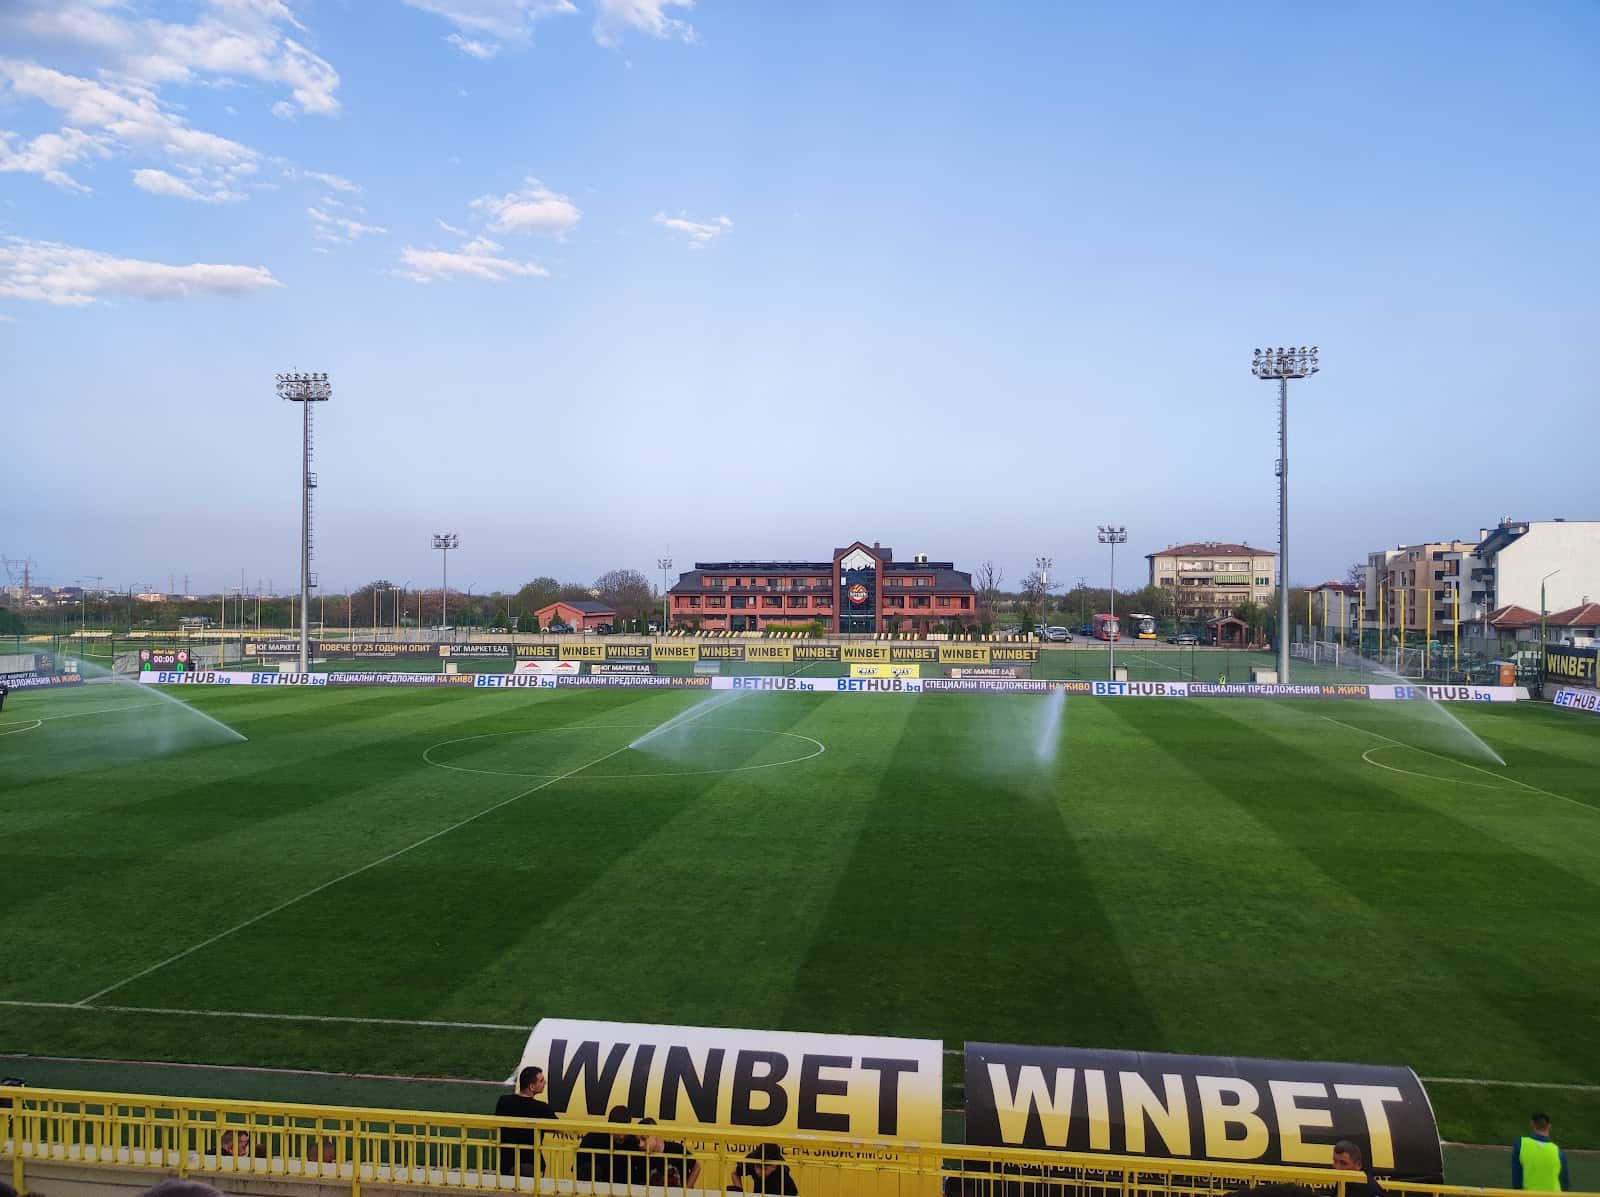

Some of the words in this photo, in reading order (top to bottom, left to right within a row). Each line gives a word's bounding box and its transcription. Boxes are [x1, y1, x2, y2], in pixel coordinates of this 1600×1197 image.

[320, 644, 351, 652] ПОВЕЧЕ
[352, 644, 362, 652] ОТ
[364, 644, 373, 652] 25
[374, 644, 408, 653] ГОДИНИ
[409, 644, 431, 652] ОПИТ
[516, 646, 557, 656] WINBET
[562, 646, 602, 656] WINBET
[608, 646, 649, 657] WINBET
[654, 647, 696, 657] WINBET
[702, 647, 743, 658] WINBET
[748, 648, 790, 657] WINBET
[796, 648, 838, 658] WINBET
[844, 648, 886, 658] WINBET
[892, 648, 936, 659] WINBET
[942, 649, 986, 659] WINBET
[992, 650, 1038, 660] WINBET
[1547, 653, 1595, 678] WINBET
[328, 674, 376, 683] СПЕЦИАЛНИ
[376, 674, 435, 684] ПРЕДЛОЖЕНИЯ
[477, 676, 554, 688] BETHUB.bg
[558, 676, 608, 685] СПЕЦИАЛНИ
[609, 676, 670, 686] ПРЕДЛОЖЕНИЯ
[672, 677, 684, 685] НА
[685, 678, 710, 686] ЖИВО
[732, 678, 814, 690] BETHUB.bg
[837, 679, 921, 692] BETHUB.bg
[924, 681, 978, 690] СПЕЦИАЛНИ
[980, 681, 1046, 691] ПРЕДЛОЖЕНИЯ
[1064, 682, 1090, 692] ЖИВО
[1095, 683, 1185, 697] BETHUB.bg
[1190, 684, 1246, 694] СПЕЦИАЛНИ
[1248, 685, 1320, 696] ПРЕДЛОЖЕНИЯ
[1322, 686, 1335, 694] НА
[547, 1038, 919, 1135] WINBET
[987, 1063, 1402, 1169] WINBET
